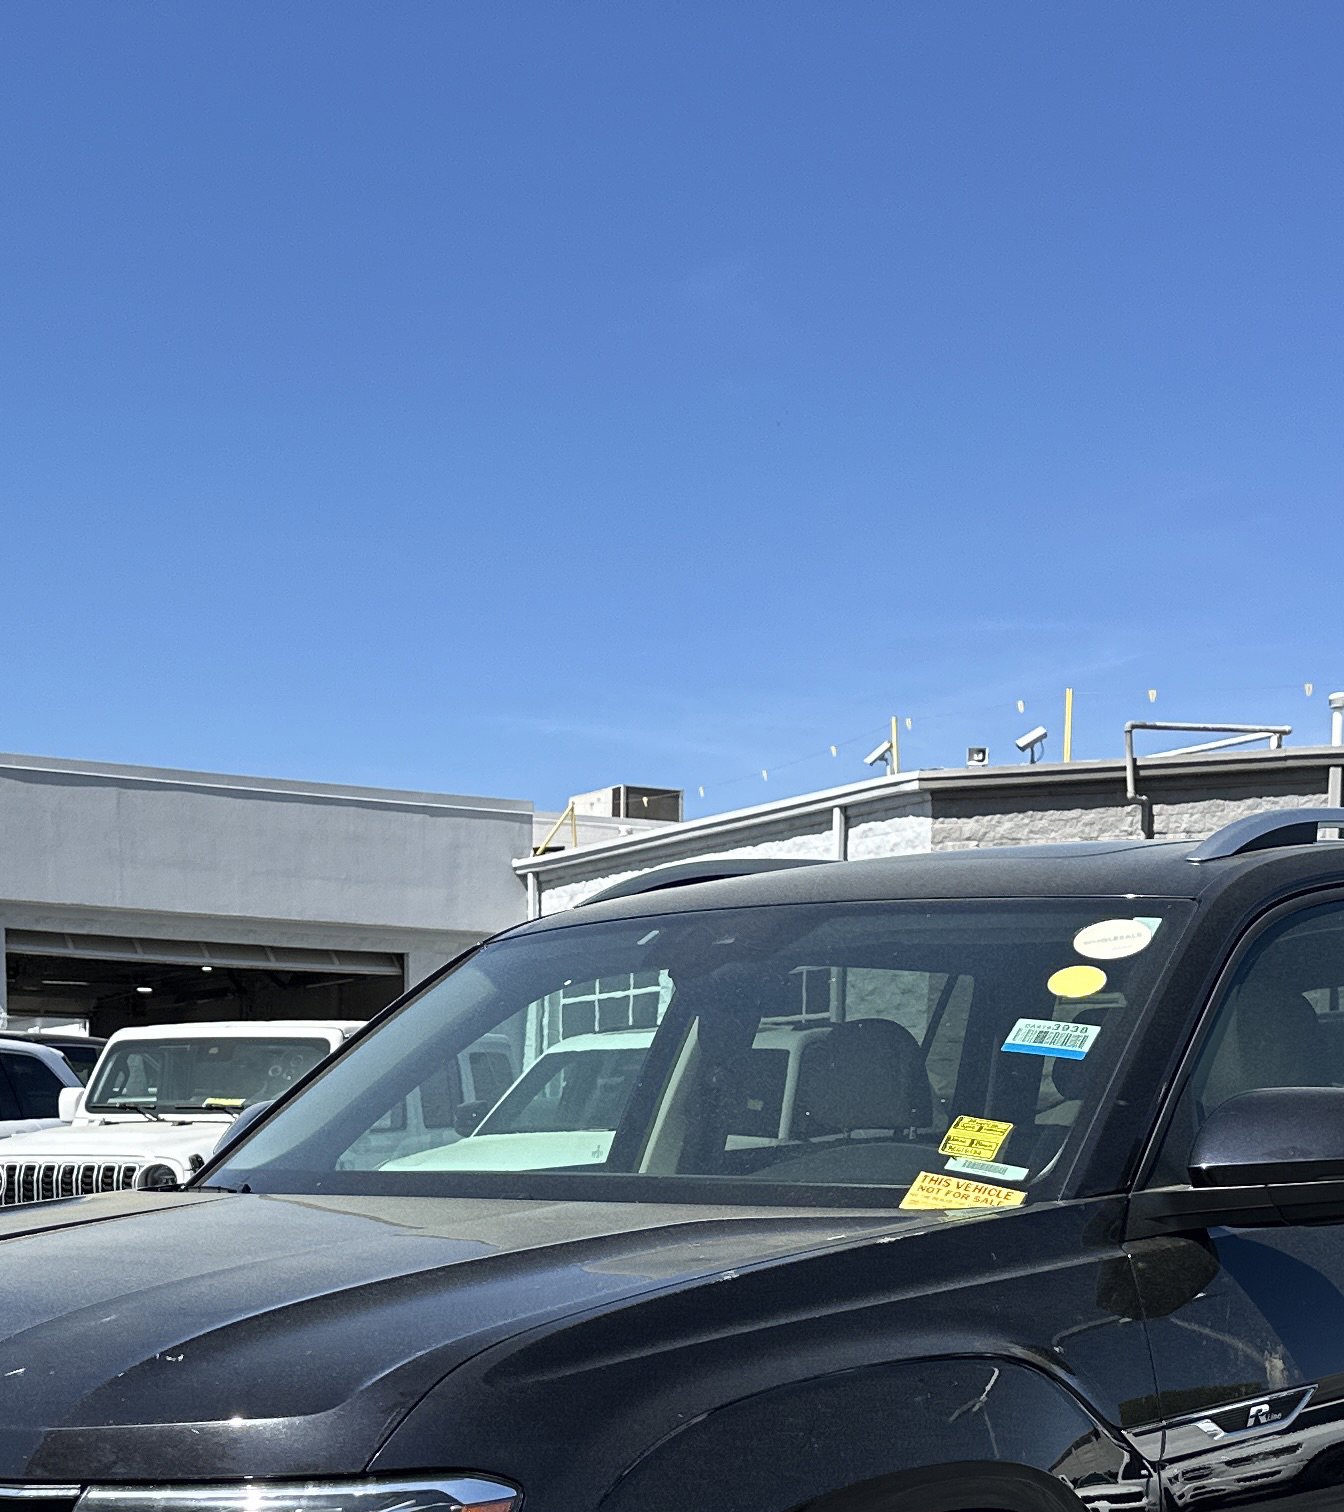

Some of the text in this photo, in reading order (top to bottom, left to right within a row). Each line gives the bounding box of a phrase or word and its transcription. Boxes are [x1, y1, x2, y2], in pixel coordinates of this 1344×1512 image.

[917, 1184, 942, 1196] NOT
[944, 1189, 970, 1201] FOR
[921, 1174, 951, 1188] THIS
[956, 1181, 1014, 1201] VEHICLE
